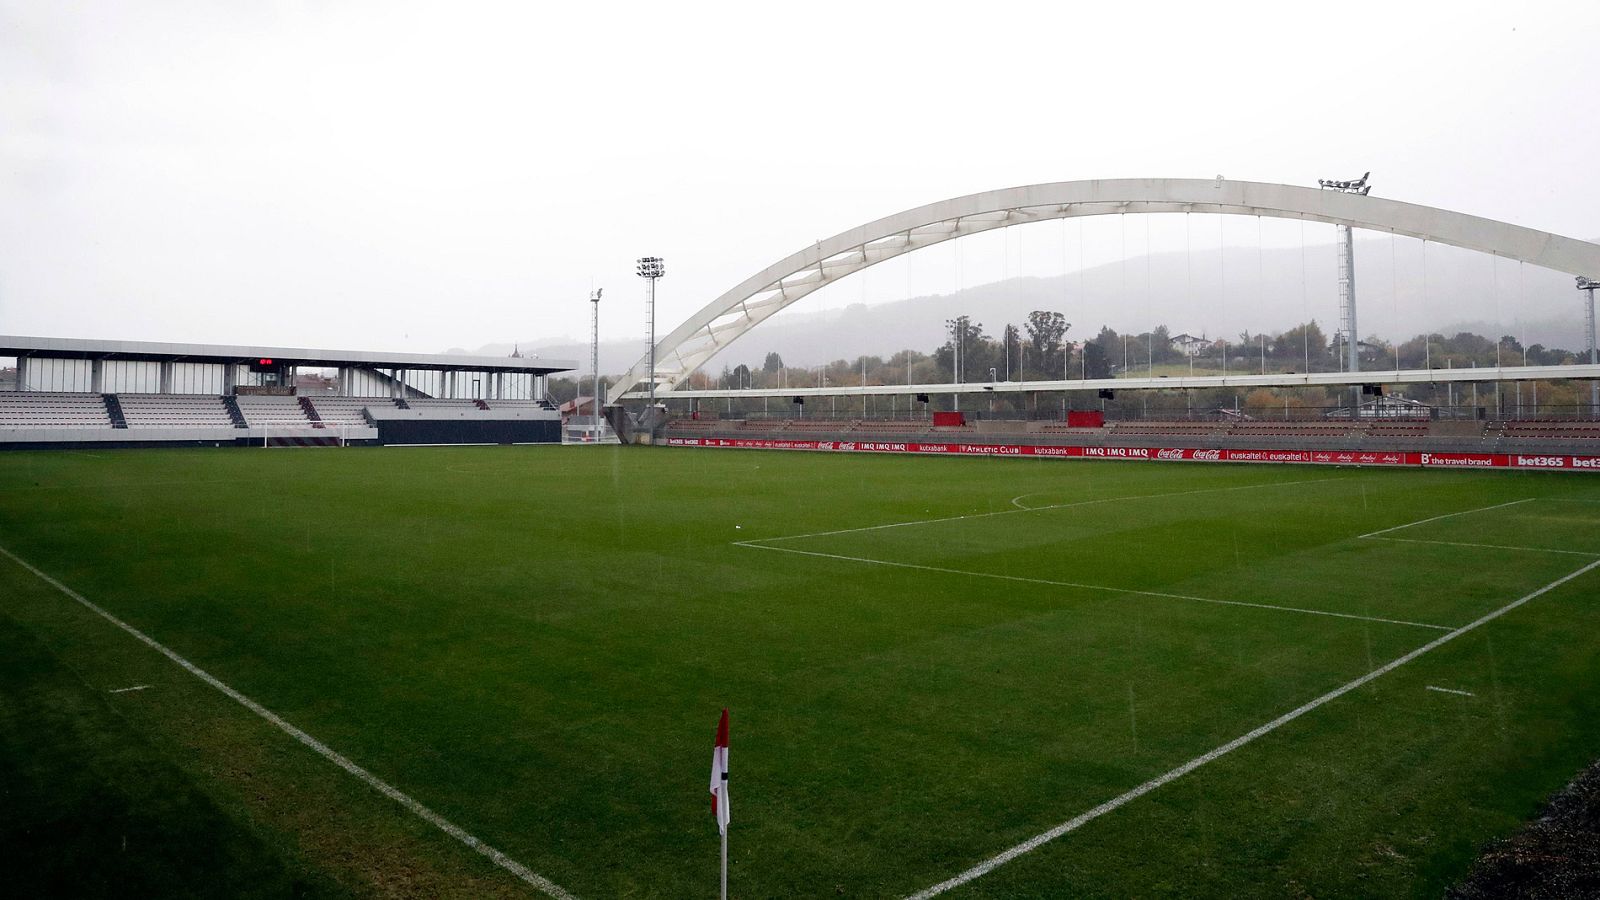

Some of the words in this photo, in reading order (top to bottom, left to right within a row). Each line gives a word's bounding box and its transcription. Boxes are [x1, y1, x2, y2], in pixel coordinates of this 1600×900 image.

[891, 443, 906, 451] IMQ
[1034, 447, 1068, 455] kutxabank
[1086, 448, 1104, 456] IMQ
[1107, 448, 1126, 456] IMQ
[1129, 448, 1148, 457] IMQ
[1230, 452, 1261, 460] euskaltel
[1269, 453, 1302, 461] euskaltel
[1431, 457, 1444, 465] the
[1445, 457, 1467, 466] travel
[1468, 458, 1492, 466] brand
[1517, 456, 1564, 467] bet365
